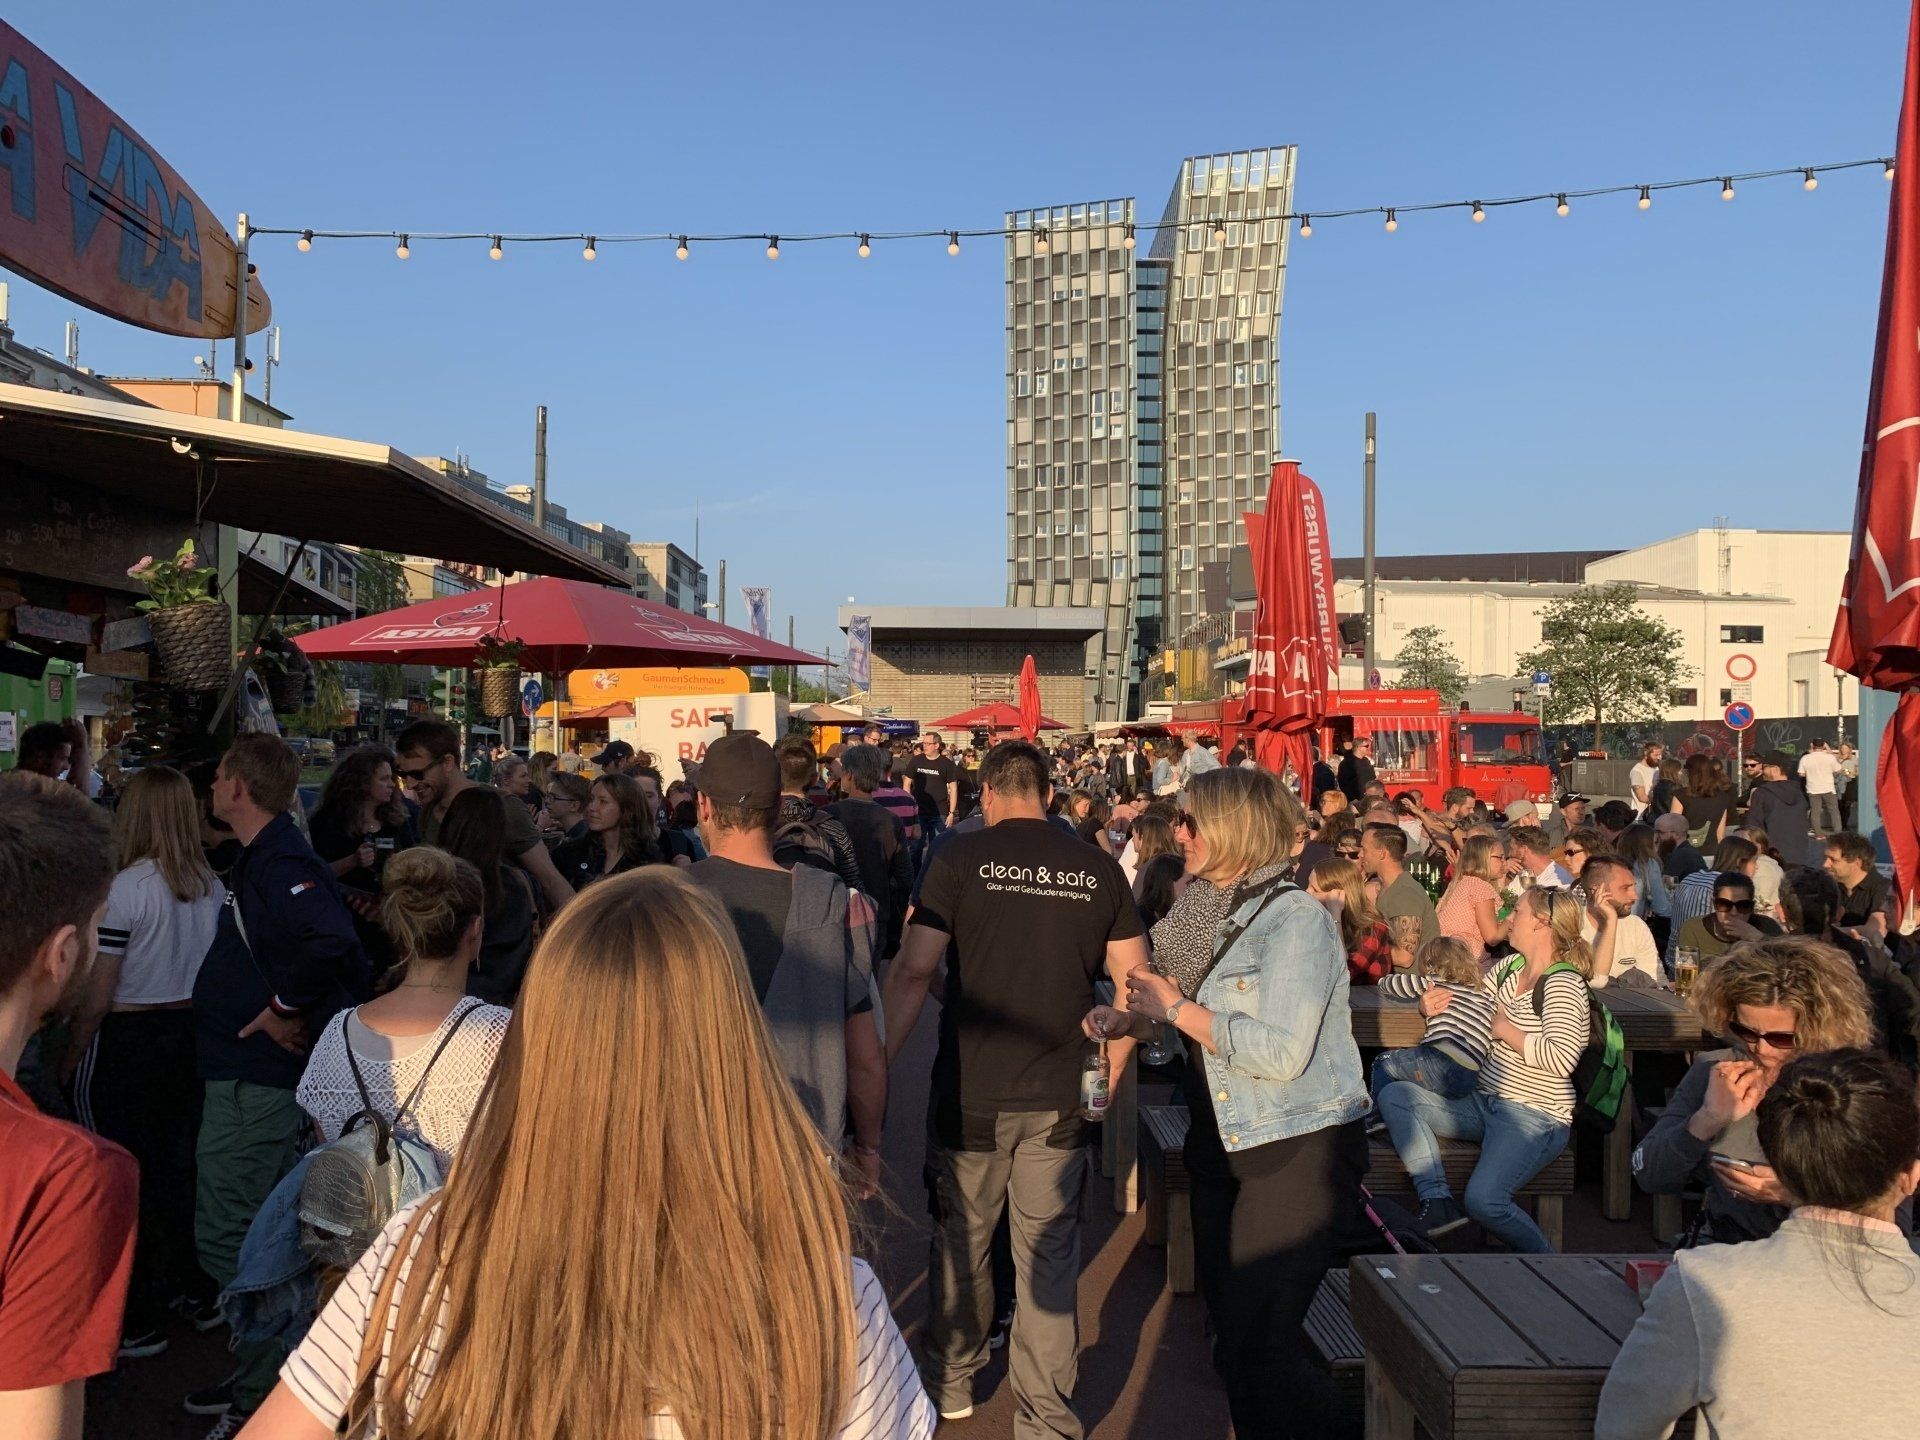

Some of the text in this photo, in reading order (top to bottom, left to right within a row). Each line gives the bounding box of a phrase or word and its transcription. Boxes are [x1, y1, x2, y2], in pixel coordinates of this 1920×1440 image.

[369, 626, 482, 640] ASTRA
[658, 630, 743, 646] ASTRA
[678, 741, 709, 762] BA
[979, 861, 1098, 889] clean & safe
[986, 882, 1091, 902] Glas- und Gebäudereinigung
